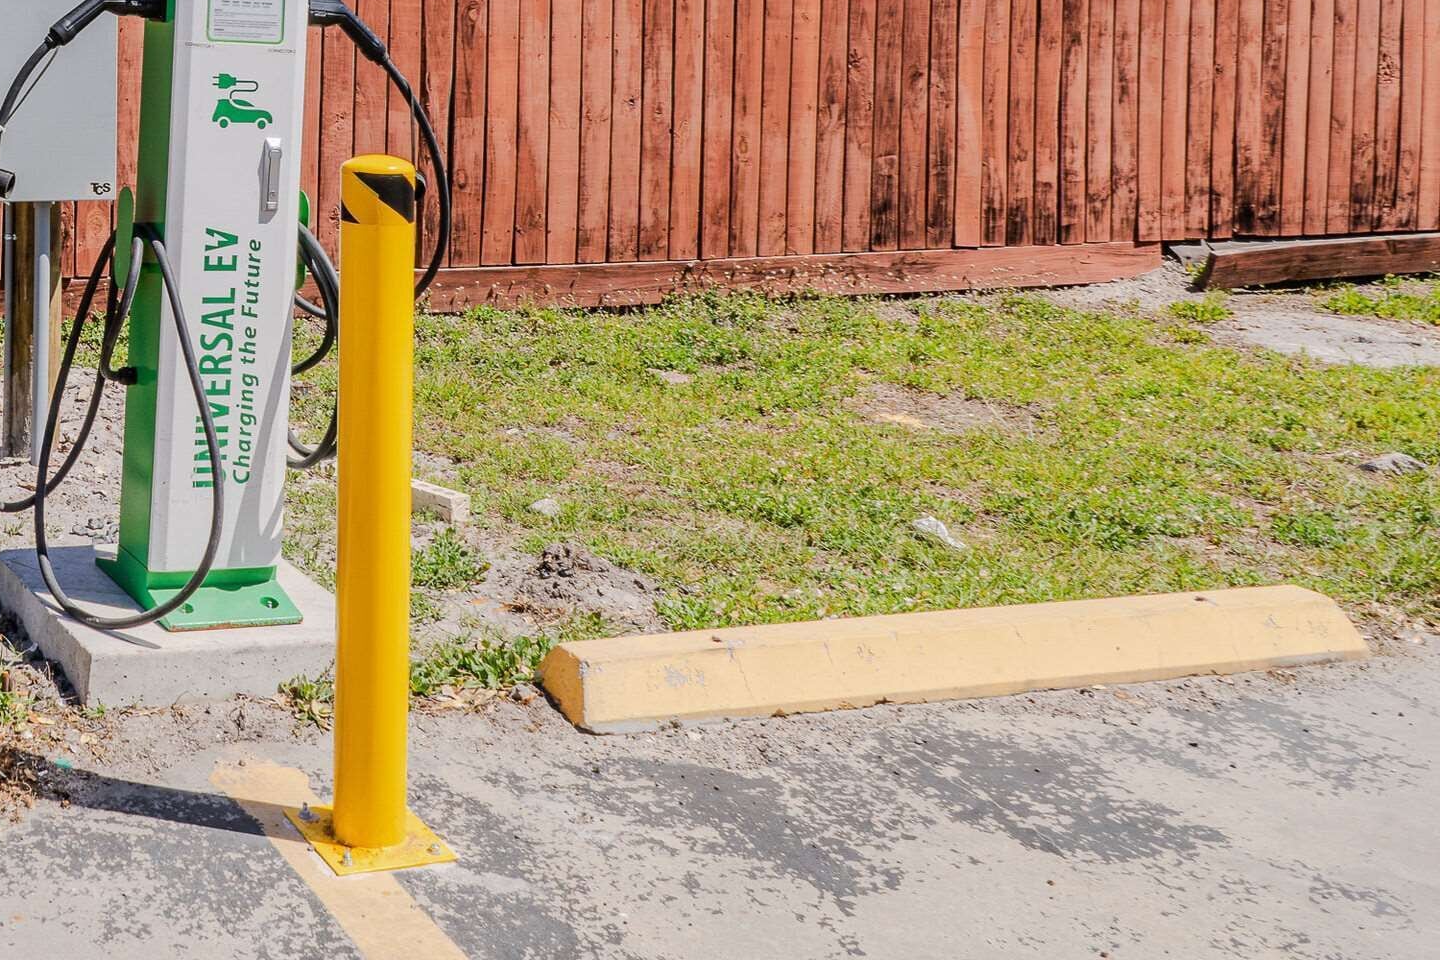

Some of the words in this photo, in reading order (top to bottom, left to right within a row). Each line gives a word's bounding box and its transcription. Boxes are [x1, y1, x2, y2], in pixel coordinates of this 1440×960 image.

[90, 182, 111, 195] TCS
[204, 227, 239, 271] EV
[241, 239, 261, 318] Future
[239, 326, 257, 365] the
[192, 288, 236, 488] UNIVERSAL
[233, 373, 259, 484] Charging
